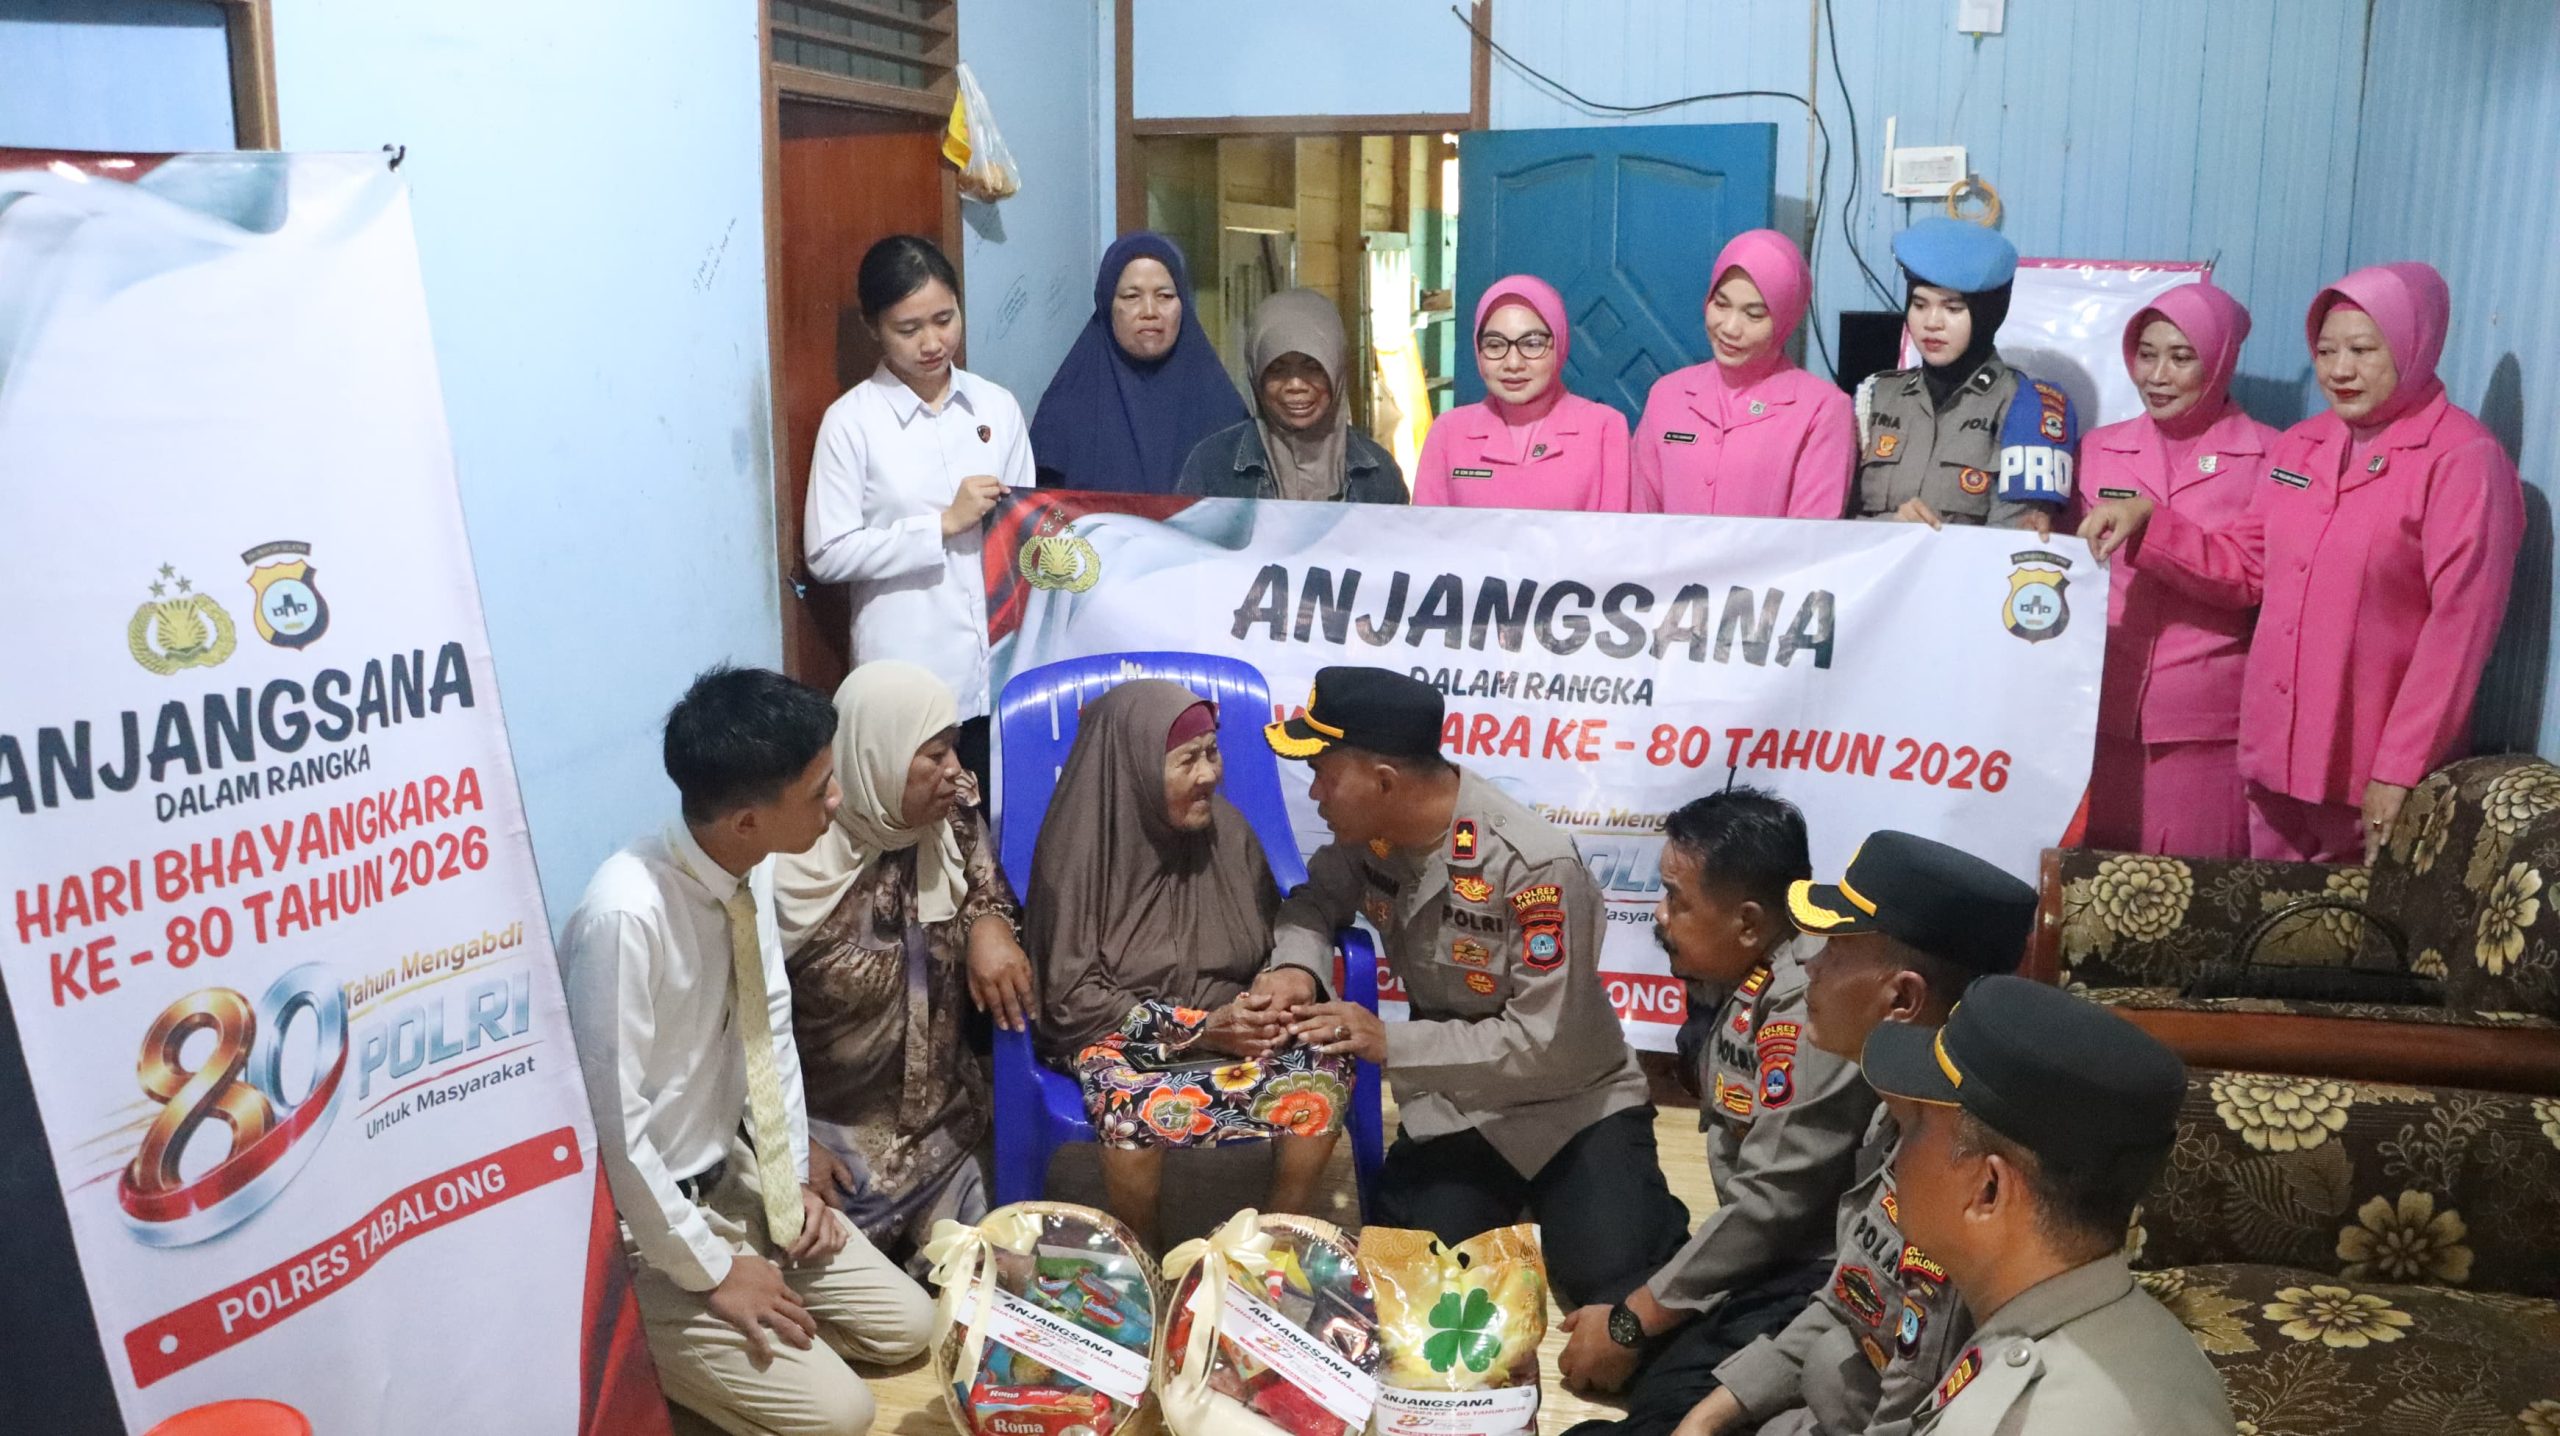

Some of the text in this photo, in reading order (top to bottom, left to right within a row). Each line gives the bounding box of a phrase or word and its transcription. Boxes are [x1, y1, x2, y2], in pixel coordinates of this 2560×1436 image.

[1231, 564, 1836, 669] ANJANGSANA
[1523, 672, 1654, 707] RANGKA
[0, 641, 475, 815] ANJANGSANA
[1542, 717, 1607, 762] KE
[1646, 723, 1711, 768] 80
[1725, 728, 1886, 777] TAHUN
[1889, 738, 2012, 794] 2026
[156, 744, 371, 823] DALAM RANGKA
[1536, 803, 1668, 831] Tahun Meng
[15, 767, 484, 944] HARI BHAYANGKARA
[49, 937, 122, 1006] KE
[166, 907, 234, 969] 80
[242, 854, 385, 943] TAHUN
[390, 826, 489, 895] 2026
[1441, 904, 1503, 932] POLRI
[1516, 887, 1556, 903] POLRES
[1517, 895, 1558, 911] TABALONG
[344, 923, 524, 1009] Tahun Mengabdi
[358, 970, 530, 1100] POLRI
[1760, 1024, 1797, 1037] POLRES
[366, 1056, 536, 1140] Untuk Masyarakat
[218, 1163, 506, 1333] POLRES TABALONG
[1004, 1302, 1113, 1357] ANJANGSANA
[1249, 1306, 1352, 1379] ANJANGSANA
[989, 1390, 1019, 1398] Roma
[993, 1419, 1045, 1434] Roma
[1382, 1393, 1493, 1408] ANJANGSANA
